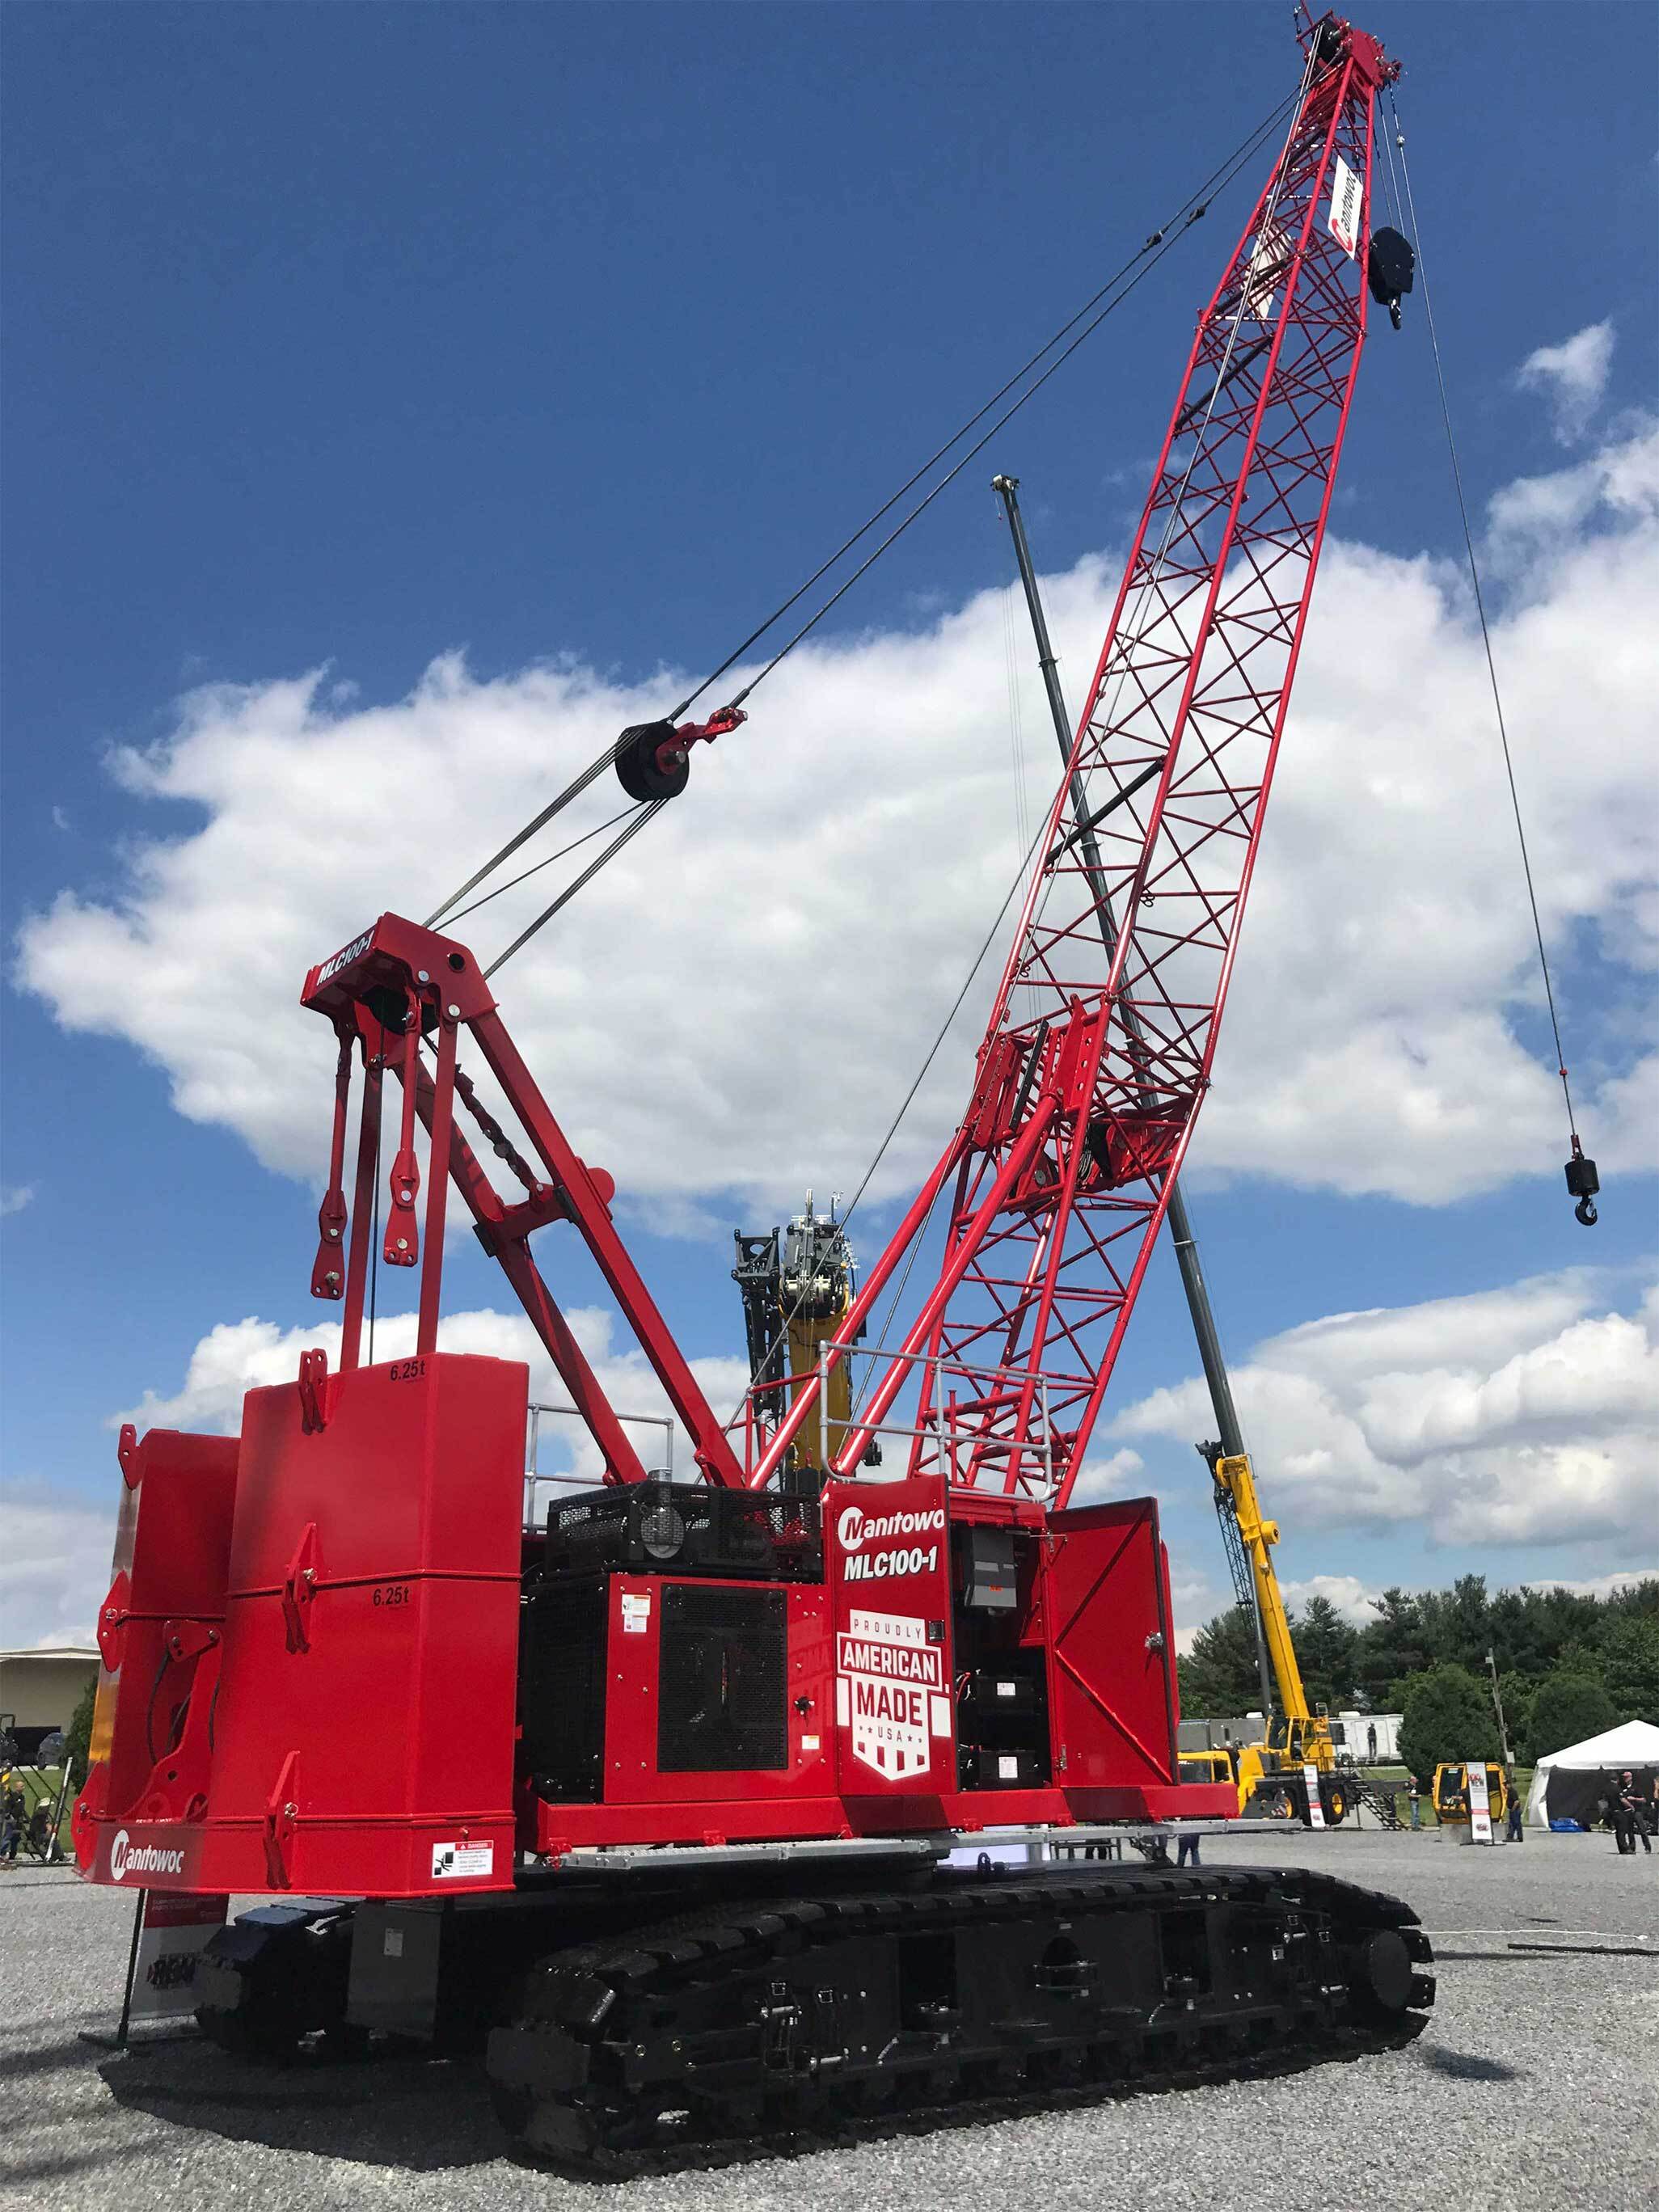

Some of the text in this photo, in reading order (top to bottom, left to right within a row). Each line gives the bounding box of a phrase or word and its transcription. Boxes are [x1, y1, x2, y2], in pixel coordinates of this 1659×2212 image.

[1332, 169, 1355, 252] Manitowoc
[317, 930, 374, 986] MLC100-1
[838, 1507, 945, 1550] Manitowo
[843, 1546, 938, 1581] MLC100-1
[854, 1619, 921, 1639] PROUDLY
[843, 1641, 935, 1682] AMERICAN
[857, 1682, 922, 1727] MADE
[877, 1726, 902, 1742] USA
[111, 1830, 184, 1881] Manitowoc
